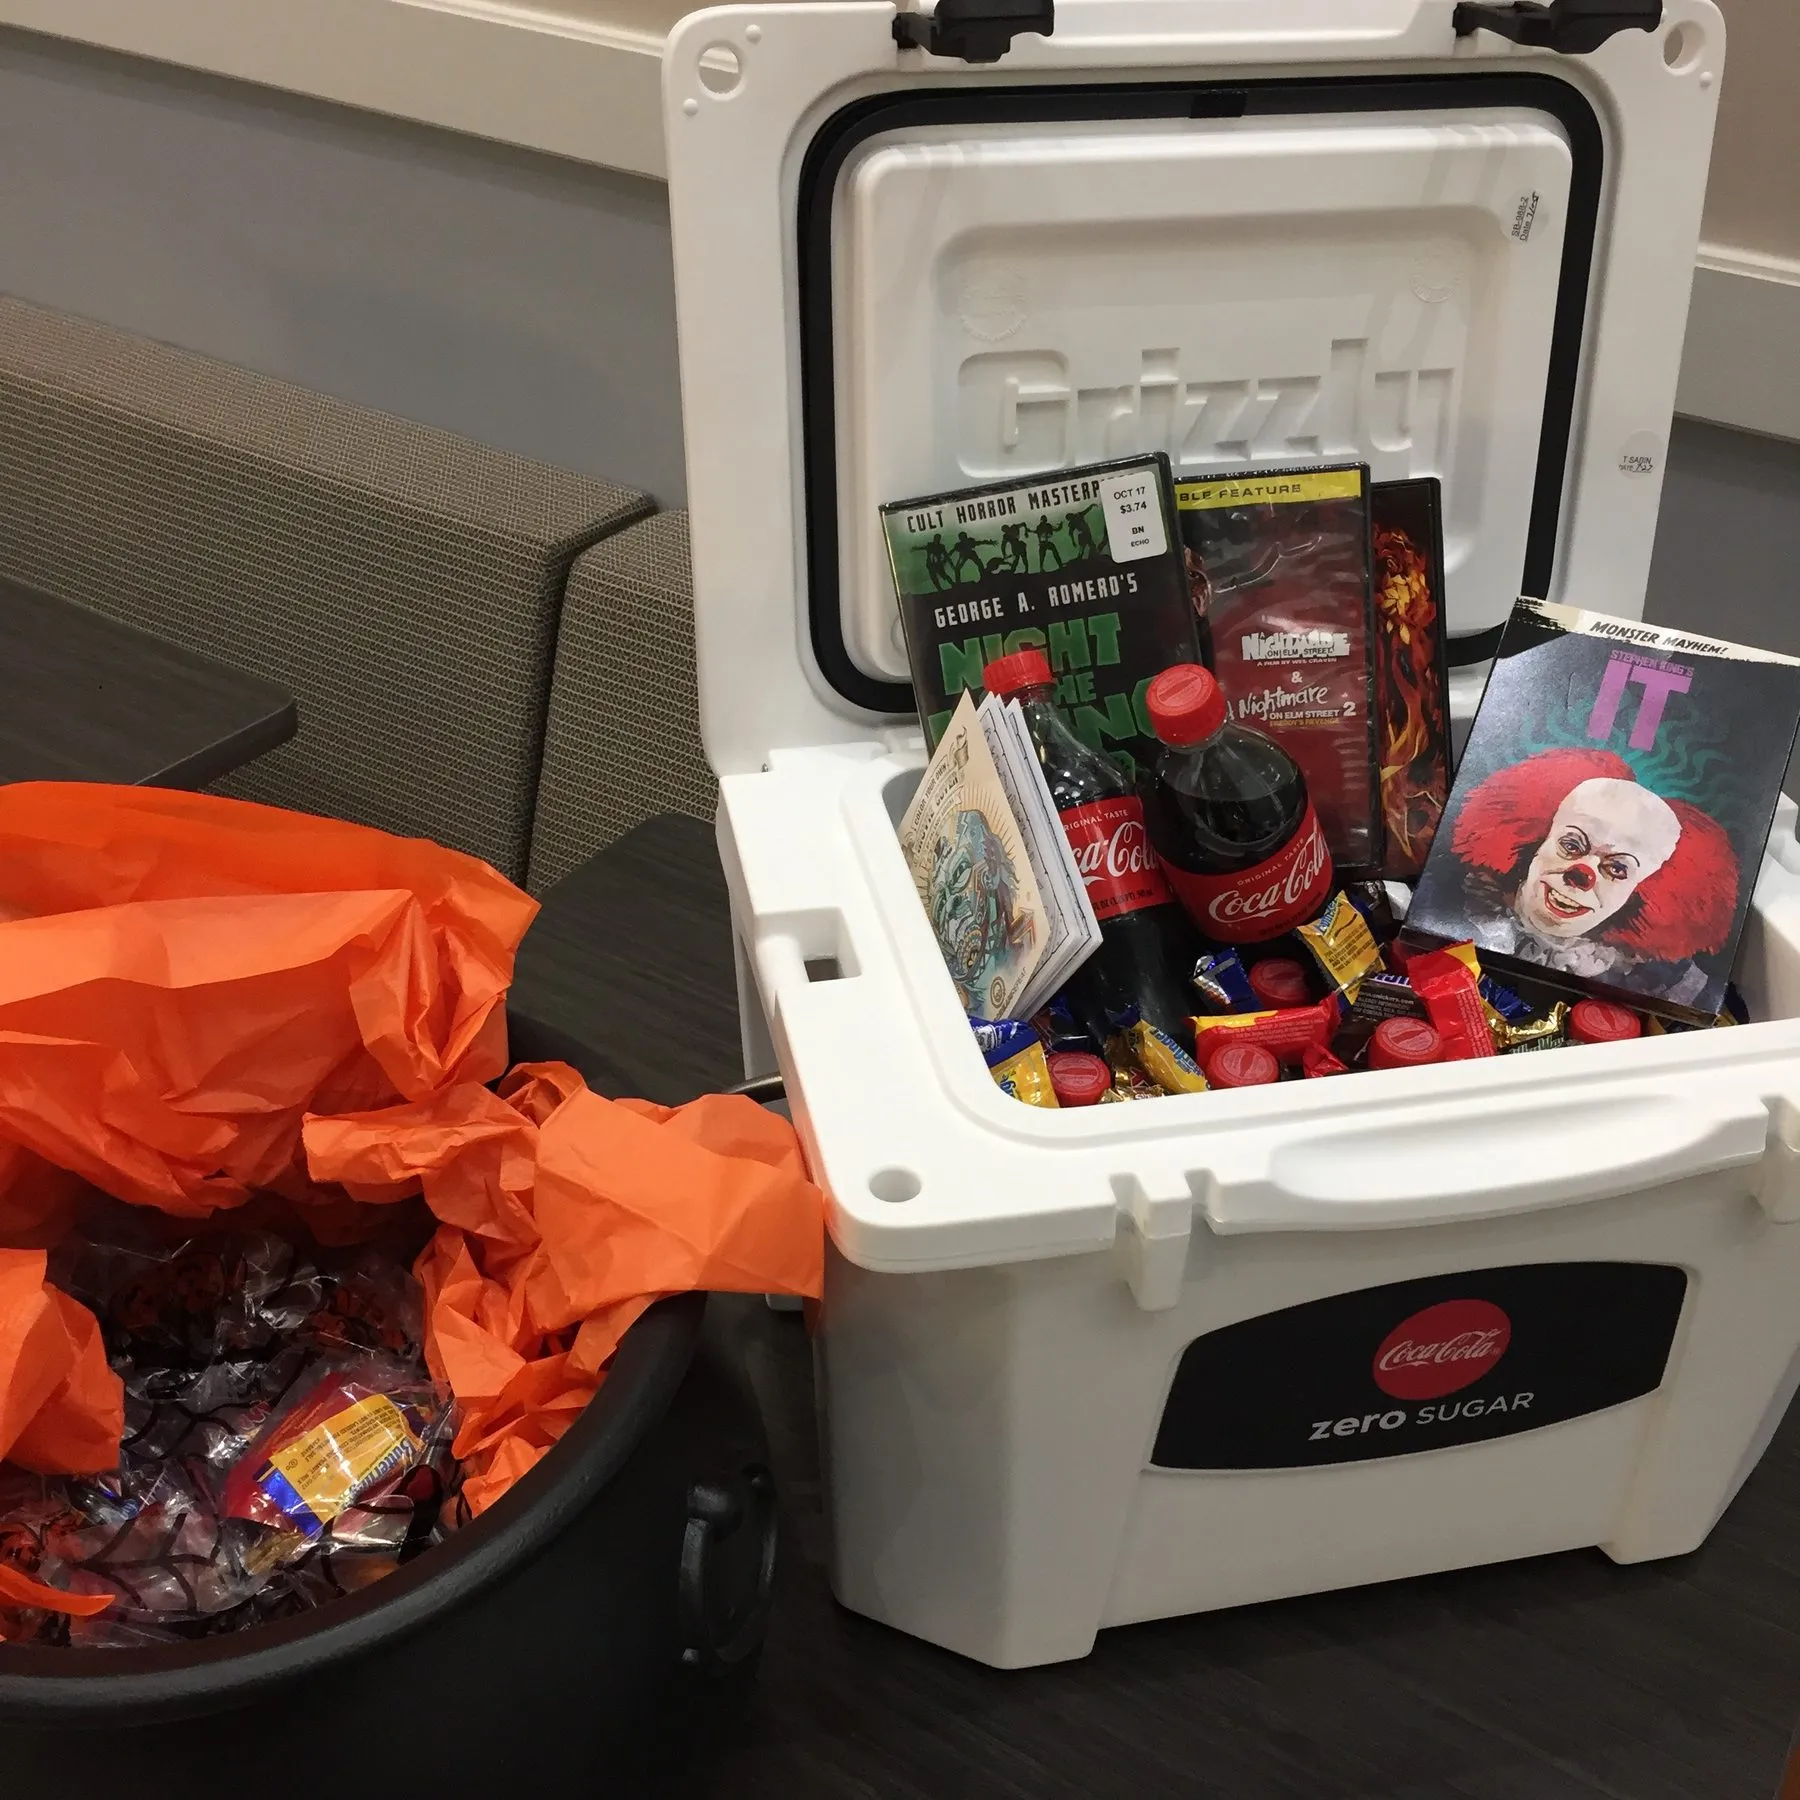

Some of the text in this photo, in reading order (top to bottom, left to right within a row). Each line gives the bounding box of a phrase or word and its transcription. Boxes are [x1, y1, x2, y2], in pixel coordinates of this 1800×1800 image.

[907, 480, 1100, 533] CULT HORROR MASTERP
[1113, 486, 1146, 500] OCT 17
[1120, 501, 1147, 514] $3.74
[1180, 484, 1301, 502] BLE FEATURE
[1131, 526, 1145, 535] BN
[1131, 538, 1150, 547] ECHO
[934, 573, 1138, 629] GEORGE A. ROMERO'S
[1304, 647, 1334, 655] STREET
[1590, 621, 1729, 655] MONSTER MAYHEM!
[1291, 671, 1303, 683] &
[1610, 650, 1695, 677] STEPHEN KING'S
[1053, 671, 1097, 704] HE
[1239, 686, 1328, 720] Nightmare
[1269, 701, 1357, 720] ON ELM STREET 2
[1585, 658, 1693, 752] IT
[1063, 809, 1129, 831] RIGINAL TASTE
[1208, 817, 1330, 923] Coca-Cola
[1237, 838, 1304, 886] ORIGINAL TASTE
[1379, 1328, 1503, 1371] Coca-Cola
[1308, 1391, 1536, 1441] zero SUGAR
